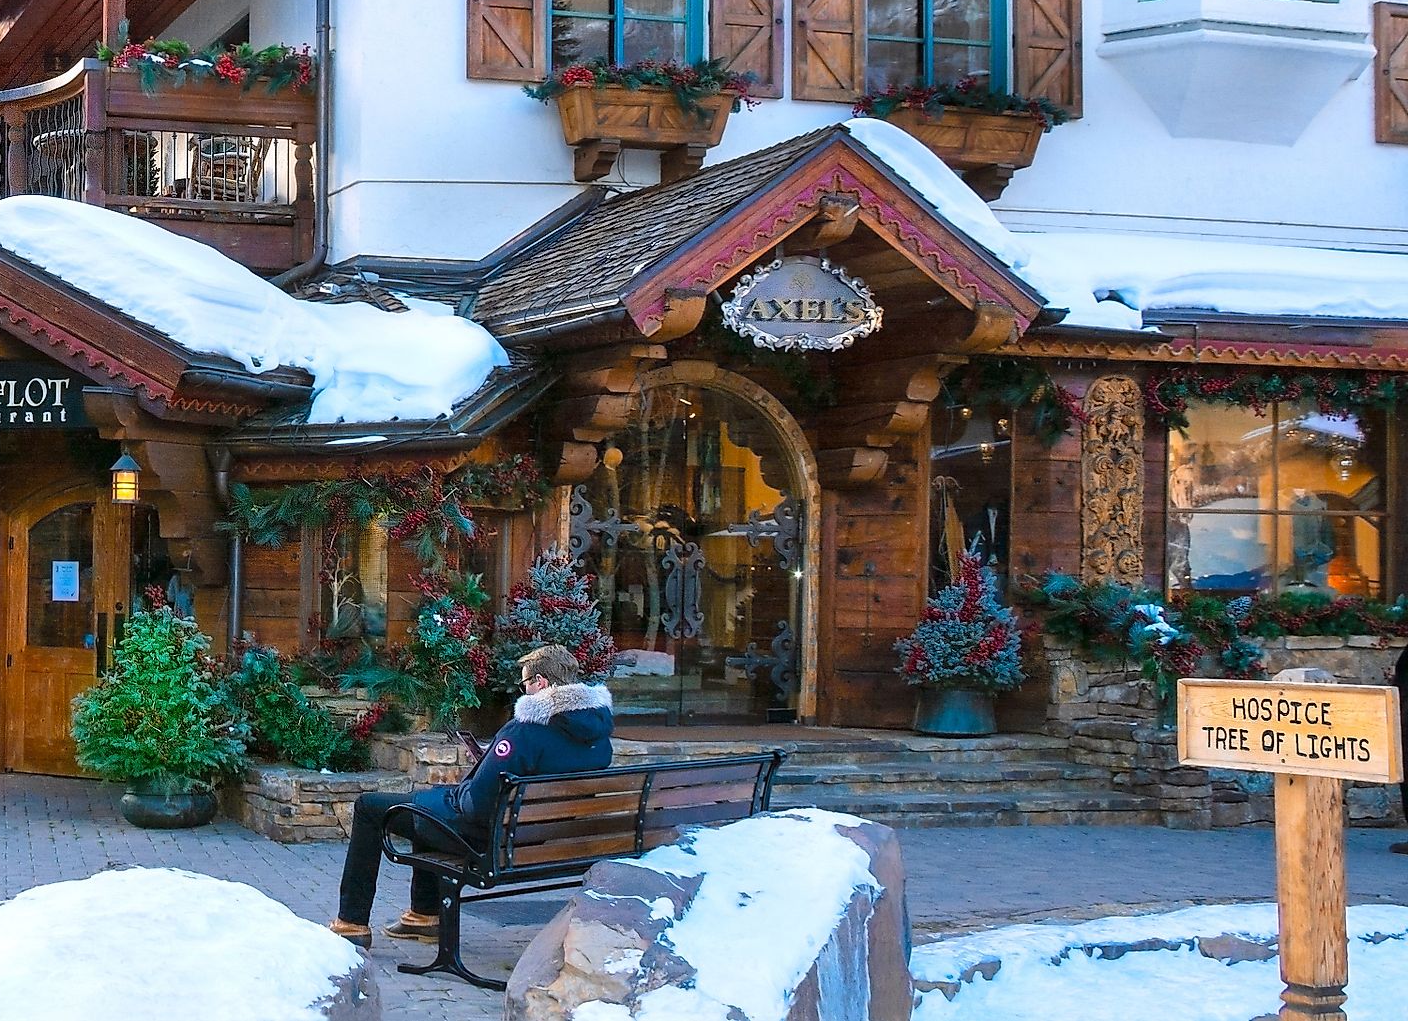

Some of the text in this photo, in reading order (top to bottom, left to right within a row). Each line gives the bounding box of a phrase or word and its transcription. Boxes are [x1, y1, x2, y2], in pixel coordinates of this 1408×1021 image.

[745, 297, 868, 322] AXEL'S
[1232, 697, 1332, 726] HOSPICE
[1201, 726, 1371, 762] TREE OF LIGHTS
